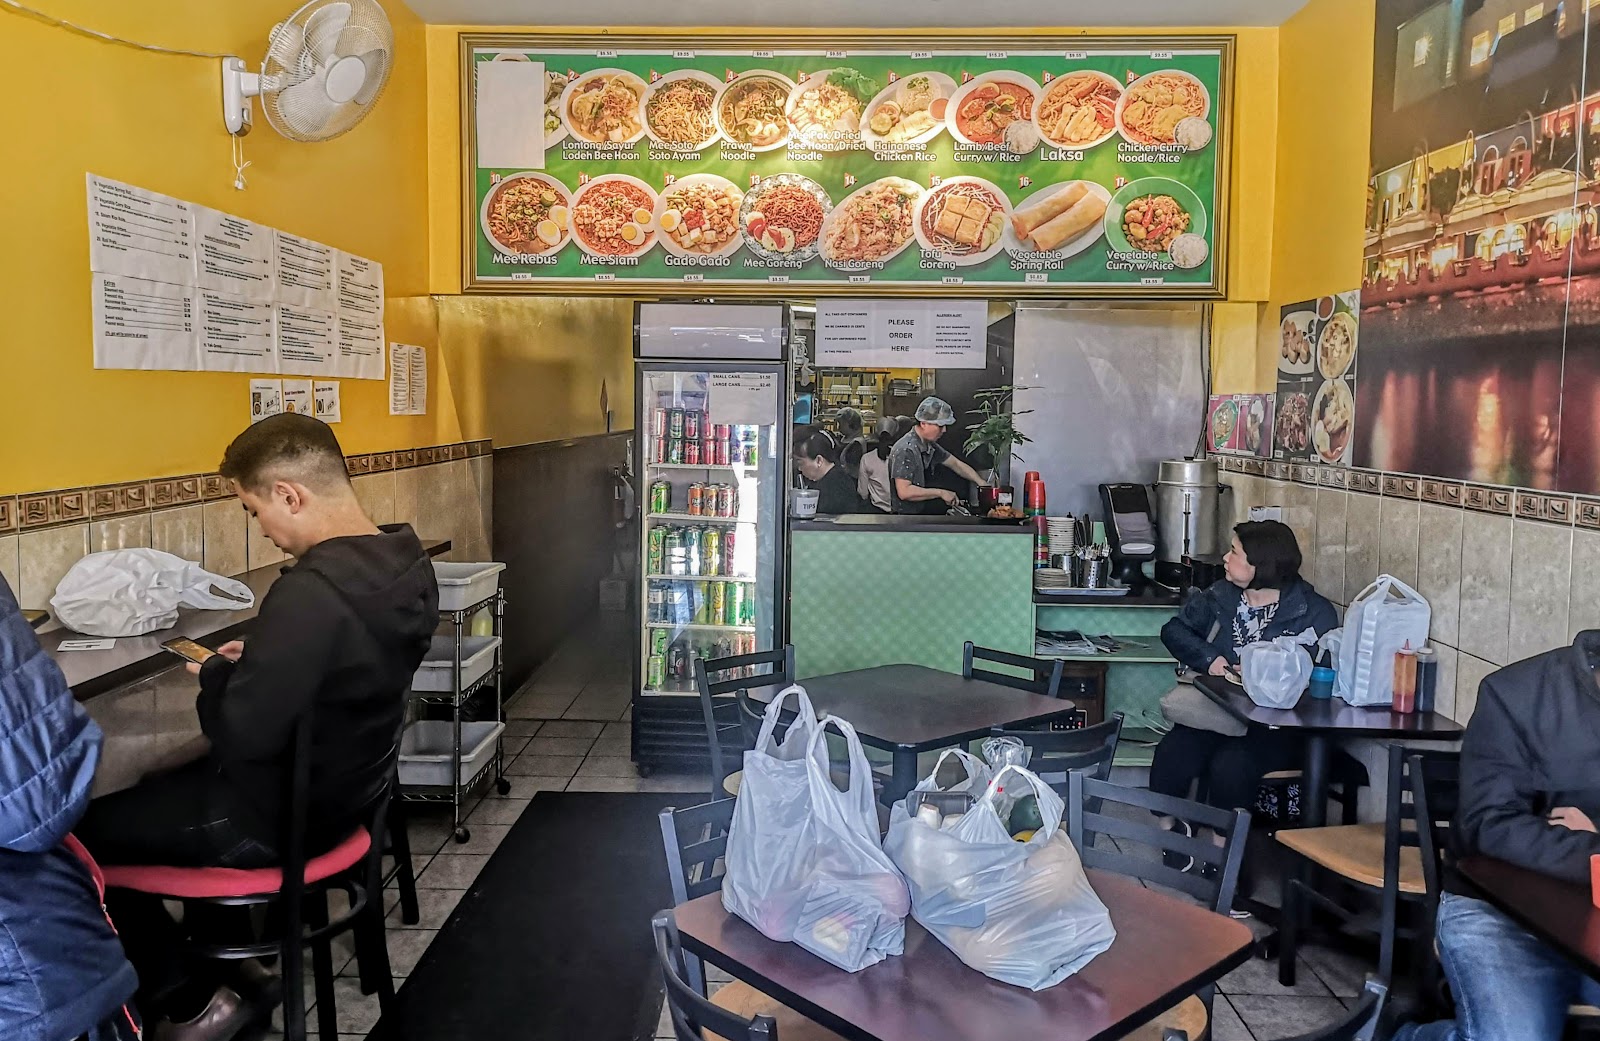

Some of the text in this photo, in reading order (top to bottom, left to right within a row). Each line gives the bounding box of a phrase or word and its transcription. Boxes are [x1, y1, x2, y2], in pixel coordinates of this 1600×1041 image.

[569, 71, 575, 80] 2
[652, 72, 658, 81] 3
[727, 72, 734, 81] 4
[800, 72, 805, 82] 5
[890, 72, 896, 82] 6
[963, 72, 969, 82] 7
[1044, 72, 1050, 82] 8
[1128, 72, 1134, 82] 9
[562, 140, 635, 151] Lontong/Sayur
[649, 140, 699, 150] Mee Soto/
[720, 141, 752, 150] Prawn
[788, 140, 866, 151] Bee Hoon/Dried
[874, 141, 927, 151] Hainanese
[954, 141, 1010, 151] Lamb/Beef
[1118, 142, 1188, 154] Chicken Curry
[562, 151, 640, 161] Lodeh Bee Hoon
[649, 151, 701, 162] Soto Ayam
[720, 151, 755, 161] Noodle
[787, 151, 823, 161] Noodle
[874, 151, 937, 161] Chicken Rice
[954, 152, 982, 163] Curry
[999, 152, 1021, 162] Rice
[1040, 148, 1084, 161] Laksa
[1118, 153, 1180, 163] Noodle/Rice
[491, 174, 500, 183] 10
[580, 174, 589, 184] 11
[665, 175, 675, 184] 12
[751, 175, 760, 184] 13
[845, 176, 854, 185] 14
[931, 177, 940, 187] 15
[1020, 177, 1029, 187] 16
[1115, 178, 1124, 187] 17
[492, 254, 558, 265] Mee Rebus
[919, 250, 941, 259] Tofu
[1010, 250, 1062, 261] Vegetable
[1106, 251, 1159, 261] Vegetable
[580, 255, 638, 266] Mee Siam
[664, 255, 730, 267] Gado Gado
[743, 258, 802, 270] Mee Goreng
[825, 259, 884, 271] Nasi Goreng
[919, 260, 956, 271] Goreng
[1010, 260, 1064, 272] Spring Roll
[1106, 261, 1135, 272] Curry
[1152, 261, 1174, 270] Rice
